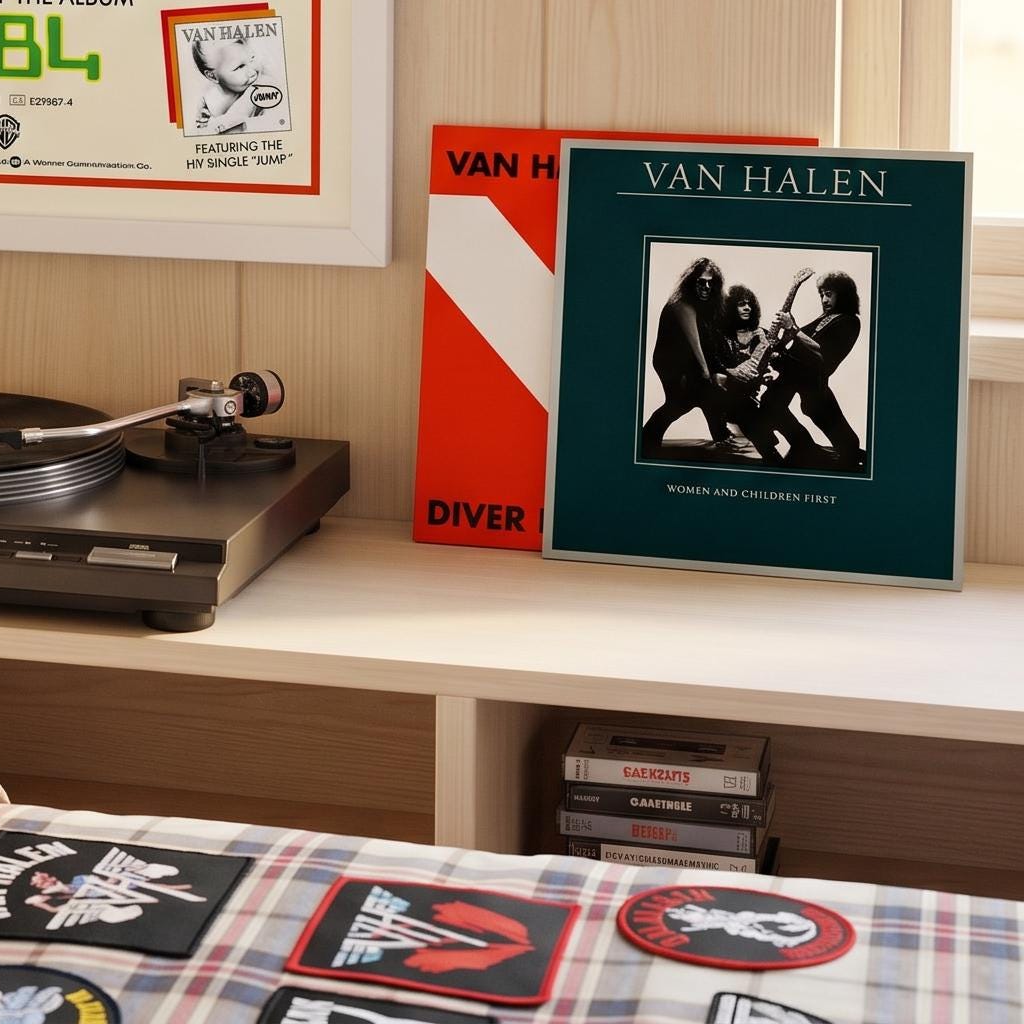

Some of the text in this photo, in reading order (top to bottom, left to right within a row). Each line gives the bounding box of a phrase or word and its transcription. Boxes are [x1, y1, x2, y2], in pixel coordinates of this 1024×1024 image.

[181, 23, 277, 43] VAN HALEN
[195, 139, 283, 154] FEATURING THE
[207, 155, 249, 168] SINGLE
[446, 150, 561, 180] VAN H
[643, 161, 887, 198] VAN HALEN
[667, 484, 838, 505] WOMEN AND CHILDREN FIRST
[427, 499, 525, 534] DIVER
